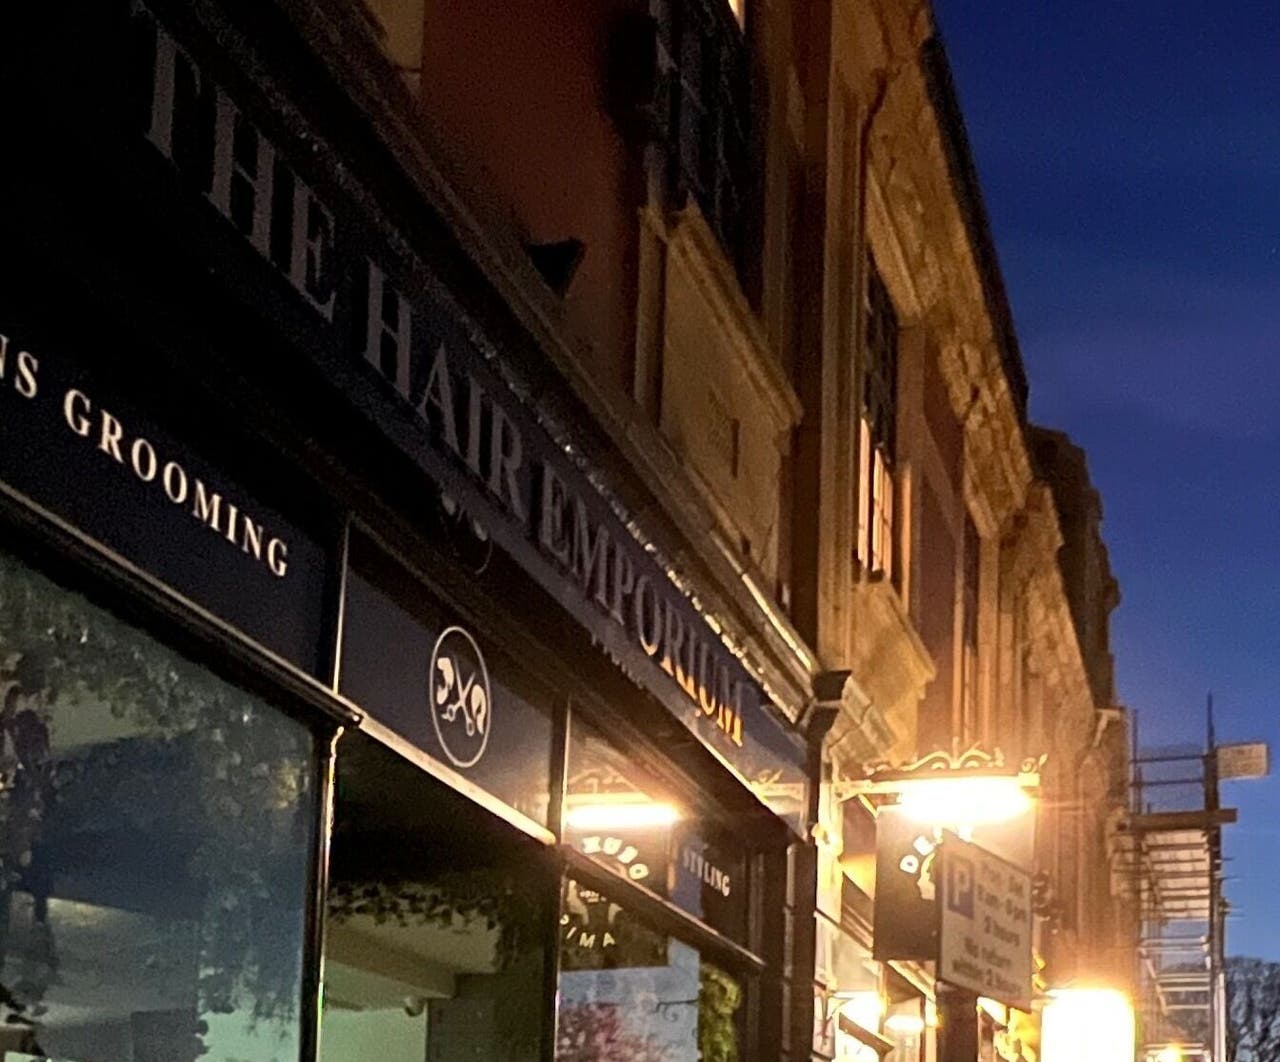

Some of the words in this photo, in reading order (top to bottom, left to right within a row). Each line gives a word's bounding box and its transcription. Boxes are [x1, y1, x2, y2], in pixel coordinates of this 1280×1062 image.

[63, 388, 289, 577] GROOMING
[141, 22, 337, 323] THE
[362, 254, 527, 526] HAIR
[539, 457, 743, 747] EMPORIUM
